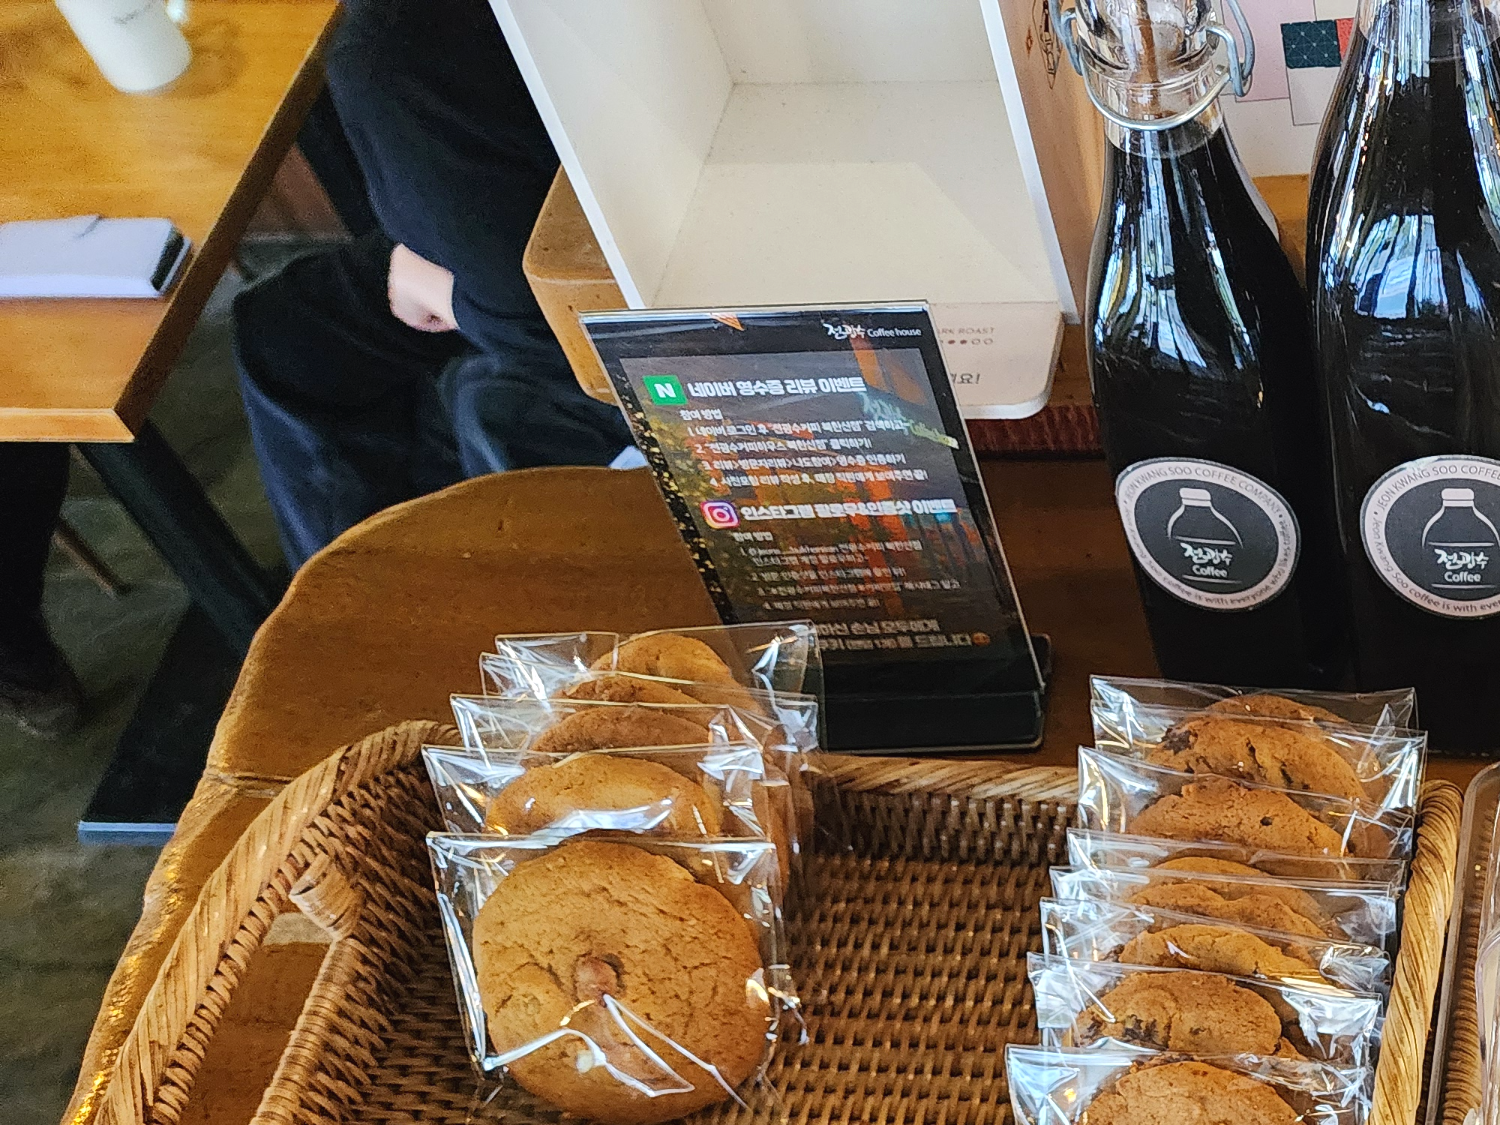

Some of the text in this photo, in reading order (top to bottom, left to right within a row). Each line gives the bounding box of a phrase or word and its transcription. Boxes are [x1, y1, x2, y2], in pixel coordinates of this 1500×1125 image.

[867, 326, 894, 338] Coffee
[895, 326, 922, 338] house
[959, 327, 995, 335] ROAST
[687, 382, 737, 399] 네이버
[736, 380, 785, 397] 영수증
[783, 378, 818, 395] 리뷰
[820, 376, 868, 393] 이벤트
[1135, 466, 1168, 487] KWANG
[1168, 466, 1192, 476] SOO
[1194, 466, 1237, 484] COFFEE
[1238, 479, 1281, 514] COMPANY
[1376, 496, 1393, 511] JEON
[1392, 468, 1431, 496] KWANG
[1432, 464, 1458, 475] SOO
[1192, 565, 1228, 577] Coffee
[1444, 572, 1482, 583] Coffee
[1392, 571, 1408, 590] Soo
[1408, 587, 1440, 608] coffee
[1441, 600, 1450, 610] is
[1453, 602, 1477, 613] with
